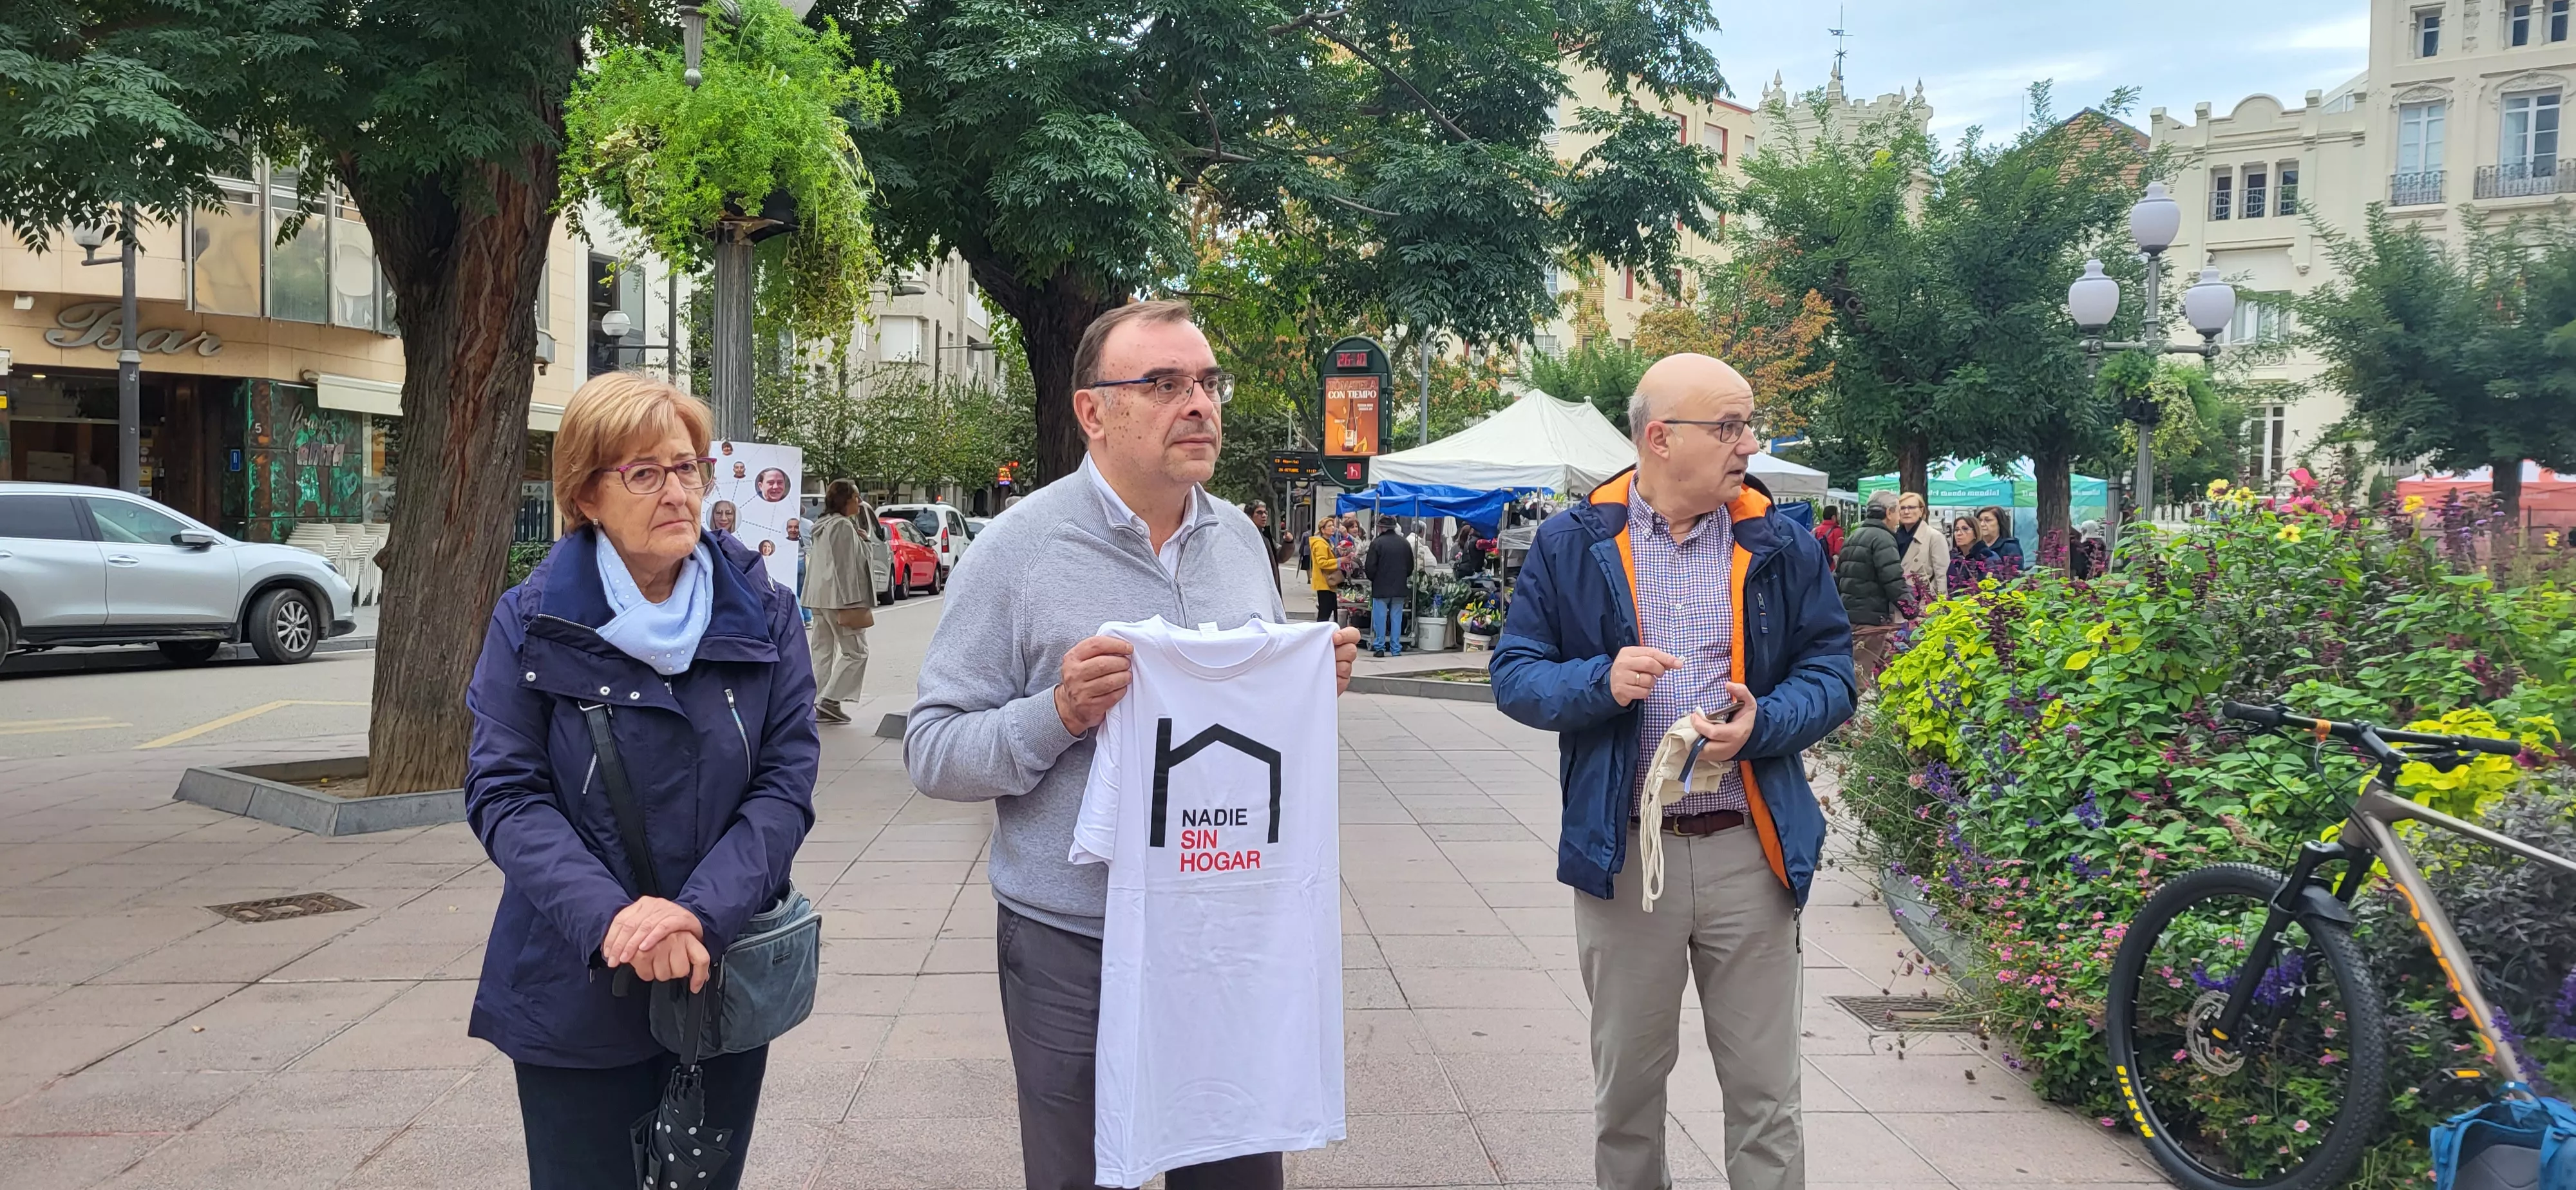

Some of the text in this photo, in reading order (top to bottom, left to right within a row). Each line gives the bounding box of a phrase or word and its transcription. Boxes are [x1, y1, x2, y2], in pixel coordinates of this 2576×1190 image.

[45, 302, 223, 356] Bar
[1328, 390, 1377, 399] CON TIEMPO
[254, 422, 262, 433] 5
[1182, 808, 1248, 827] NADIE
[1180, 829, 1218, 849] SIN
[1180, 850, 1261, 873] HOGAR
